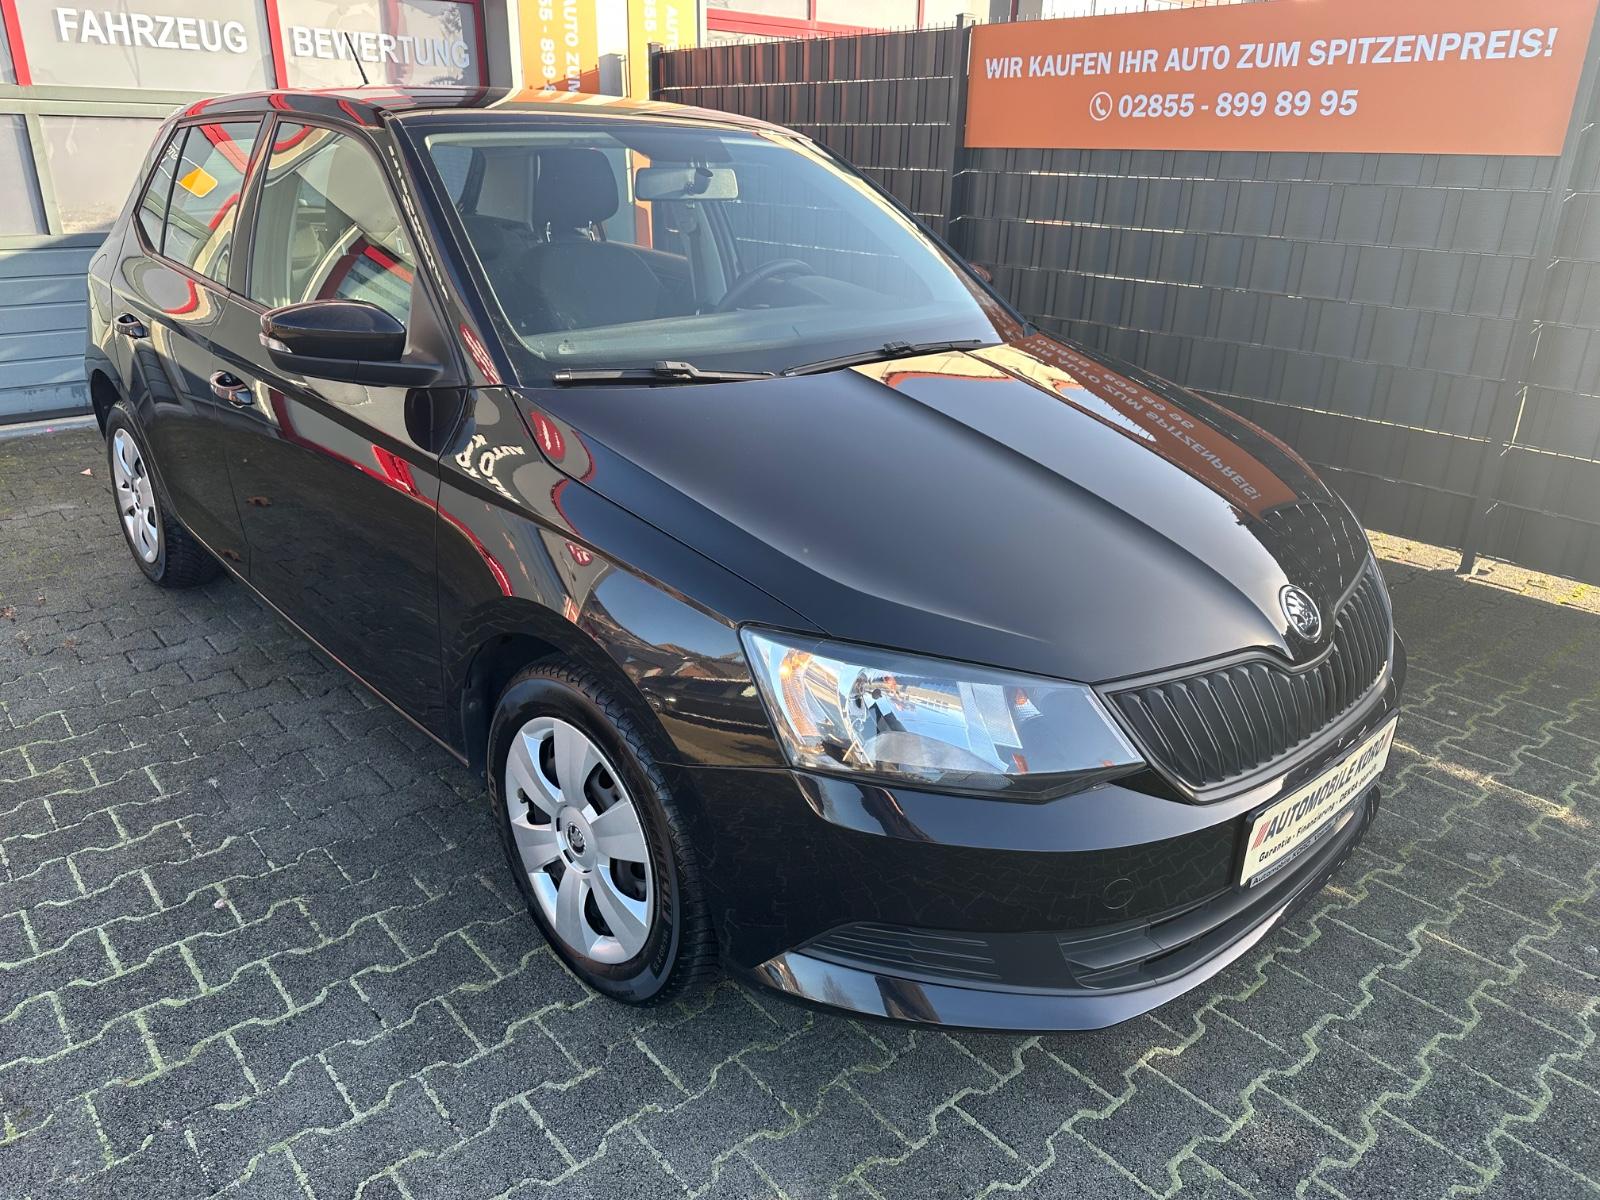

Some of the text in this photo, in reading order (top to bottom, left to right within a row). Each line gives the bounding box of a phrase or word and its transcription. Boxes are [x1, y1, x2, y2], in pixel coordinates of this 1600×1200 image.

[55, 7, 471, 69] FAHRZEUG BEWERTUNG
[540, 37, 557, 79] 899
[985, 27, 1558, 79] WIR KAUFEN IHR AUTO ZUM SPITZENPREIS!
[1118, 93, 1195, 118] 02855
[1215, 91, 1267, 117] 899
[1274, 90, 1312, 117] 89
[1319, 89, 1359, 116] 95
[1263, 759, 1358, 843] AUTOMOBILE
[1258, 835, 1292, 862] Garantie
